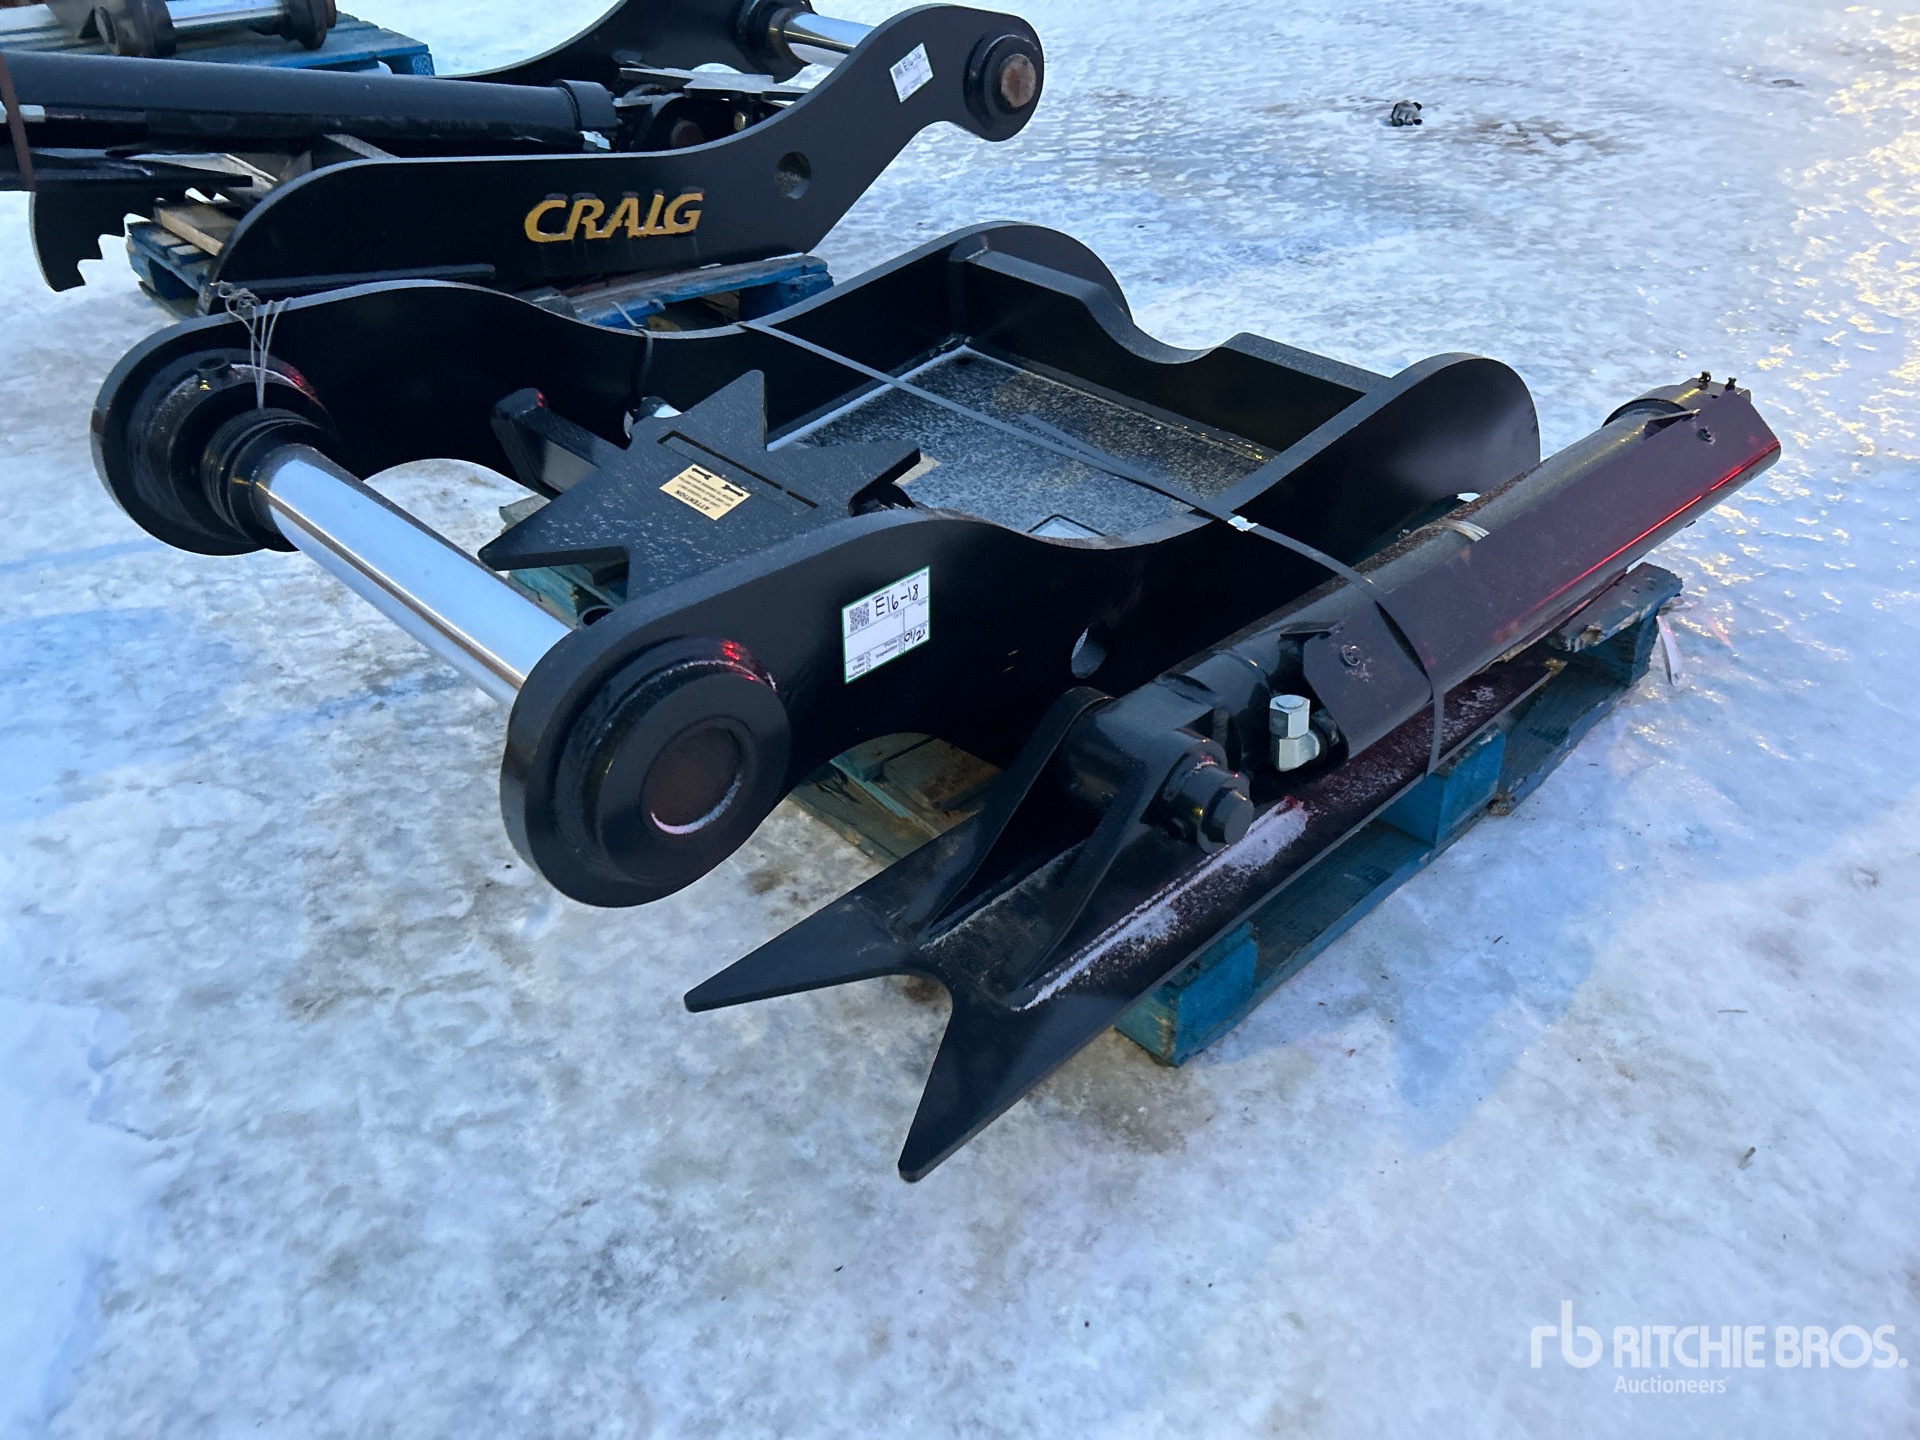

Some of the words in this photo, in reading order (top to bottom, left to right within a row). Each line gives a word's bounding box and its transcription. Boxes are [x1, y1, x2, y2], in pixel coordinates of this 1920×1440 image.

[524, 193, 703, 243] CRAIG
[675, 489, 711, 511] ATTENTION
[875, 583, 919, 617] E16-18
